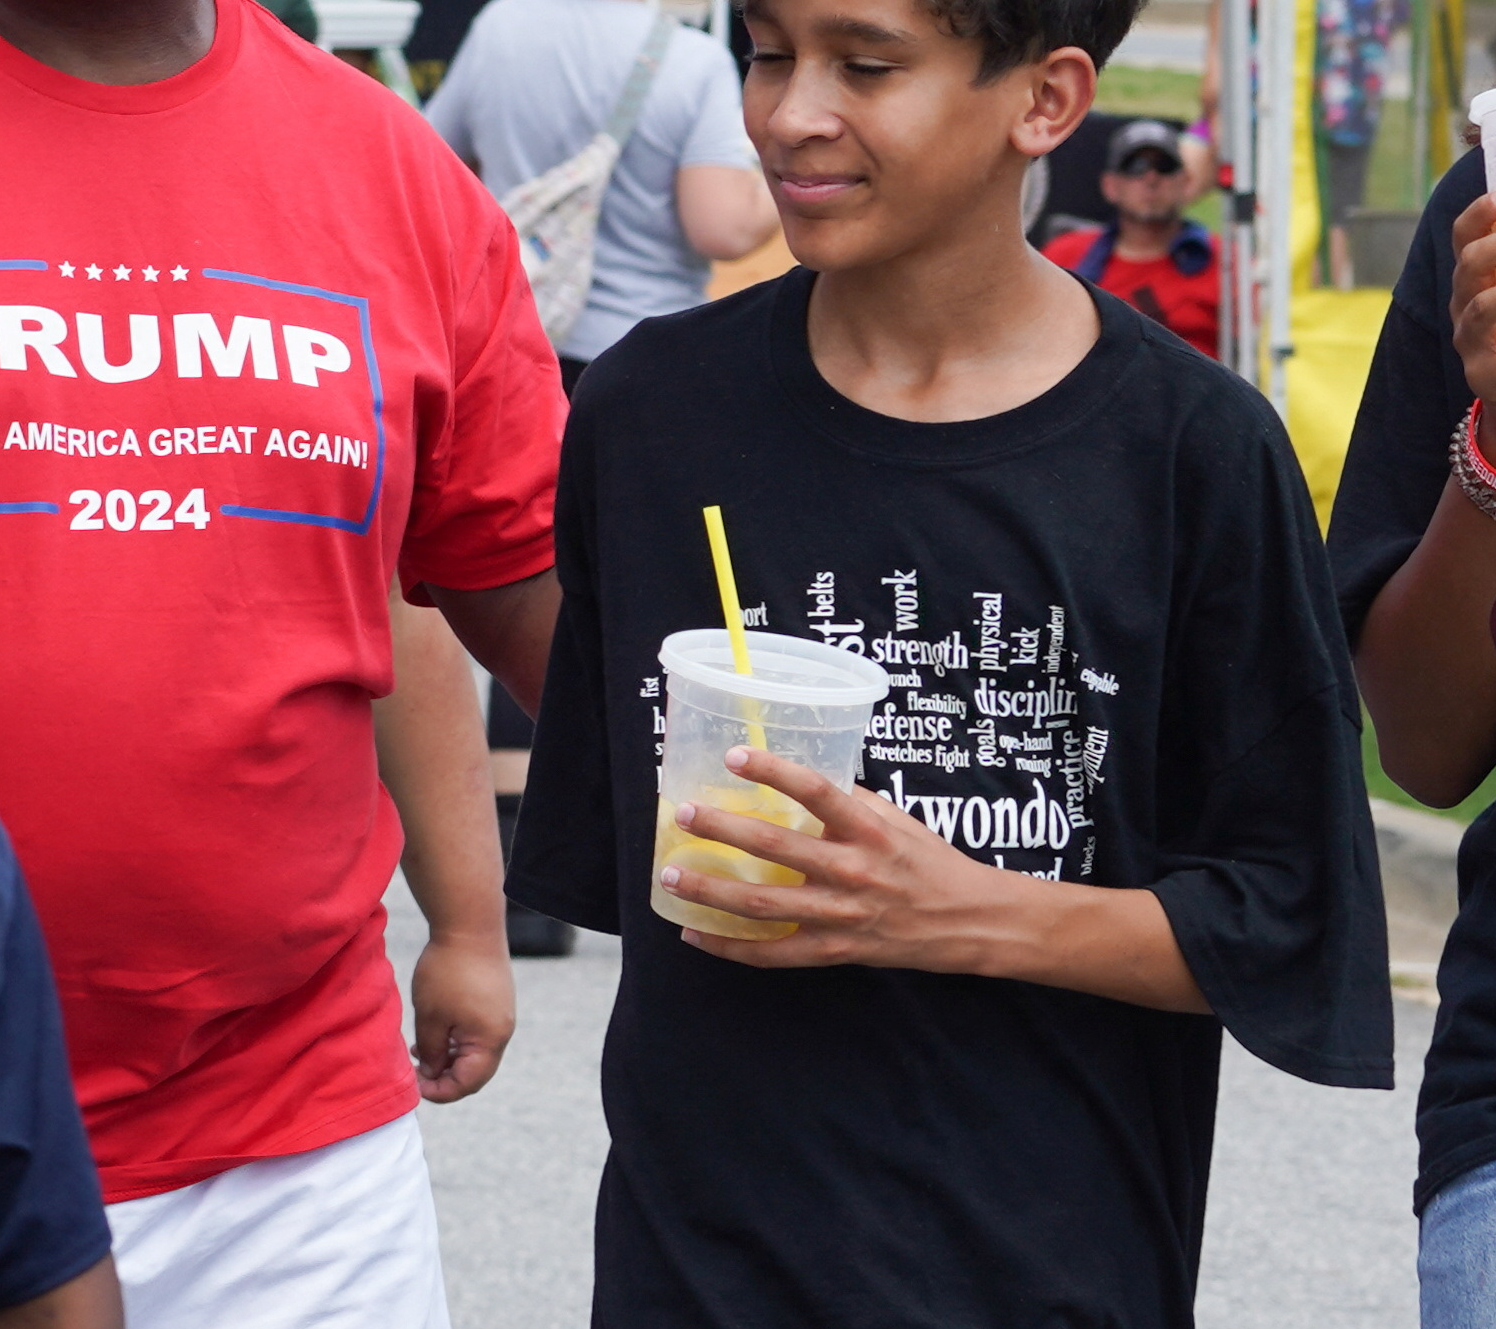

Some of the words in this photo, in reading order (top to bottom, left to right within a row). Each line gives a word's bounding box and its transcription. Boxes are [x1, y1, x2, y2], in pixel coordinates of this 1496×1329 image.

[3, 422, 143, 459] AMERICA
[147, 426, 258, 456] GREAT
[263, 429, 369, 470] AGAIN!
[67, 487, 211, 532] 2024
[806, 571, 835, 617] belts
[881, 569, 919, 632] work
[871, 631, 969, 677] strength
[970, 592, 1009, 672] physical
[1010, 627, 1040, 665] kick
[1041, 605, 1067, 673] independent
[640, 677, 659, 698] fist
[890, 668, 922, 687] unch
[907, 691, 967, 720] flexibility
[974, 676, 1078, 729] disciplin
[870, 742, 932, 763] stretches
[935, 744, 970, 773] fight
[967, 718, 1006, 768] goals
[1059, 730, 1094, 830] practice
[1080, 836, 1096, 877] blocks
